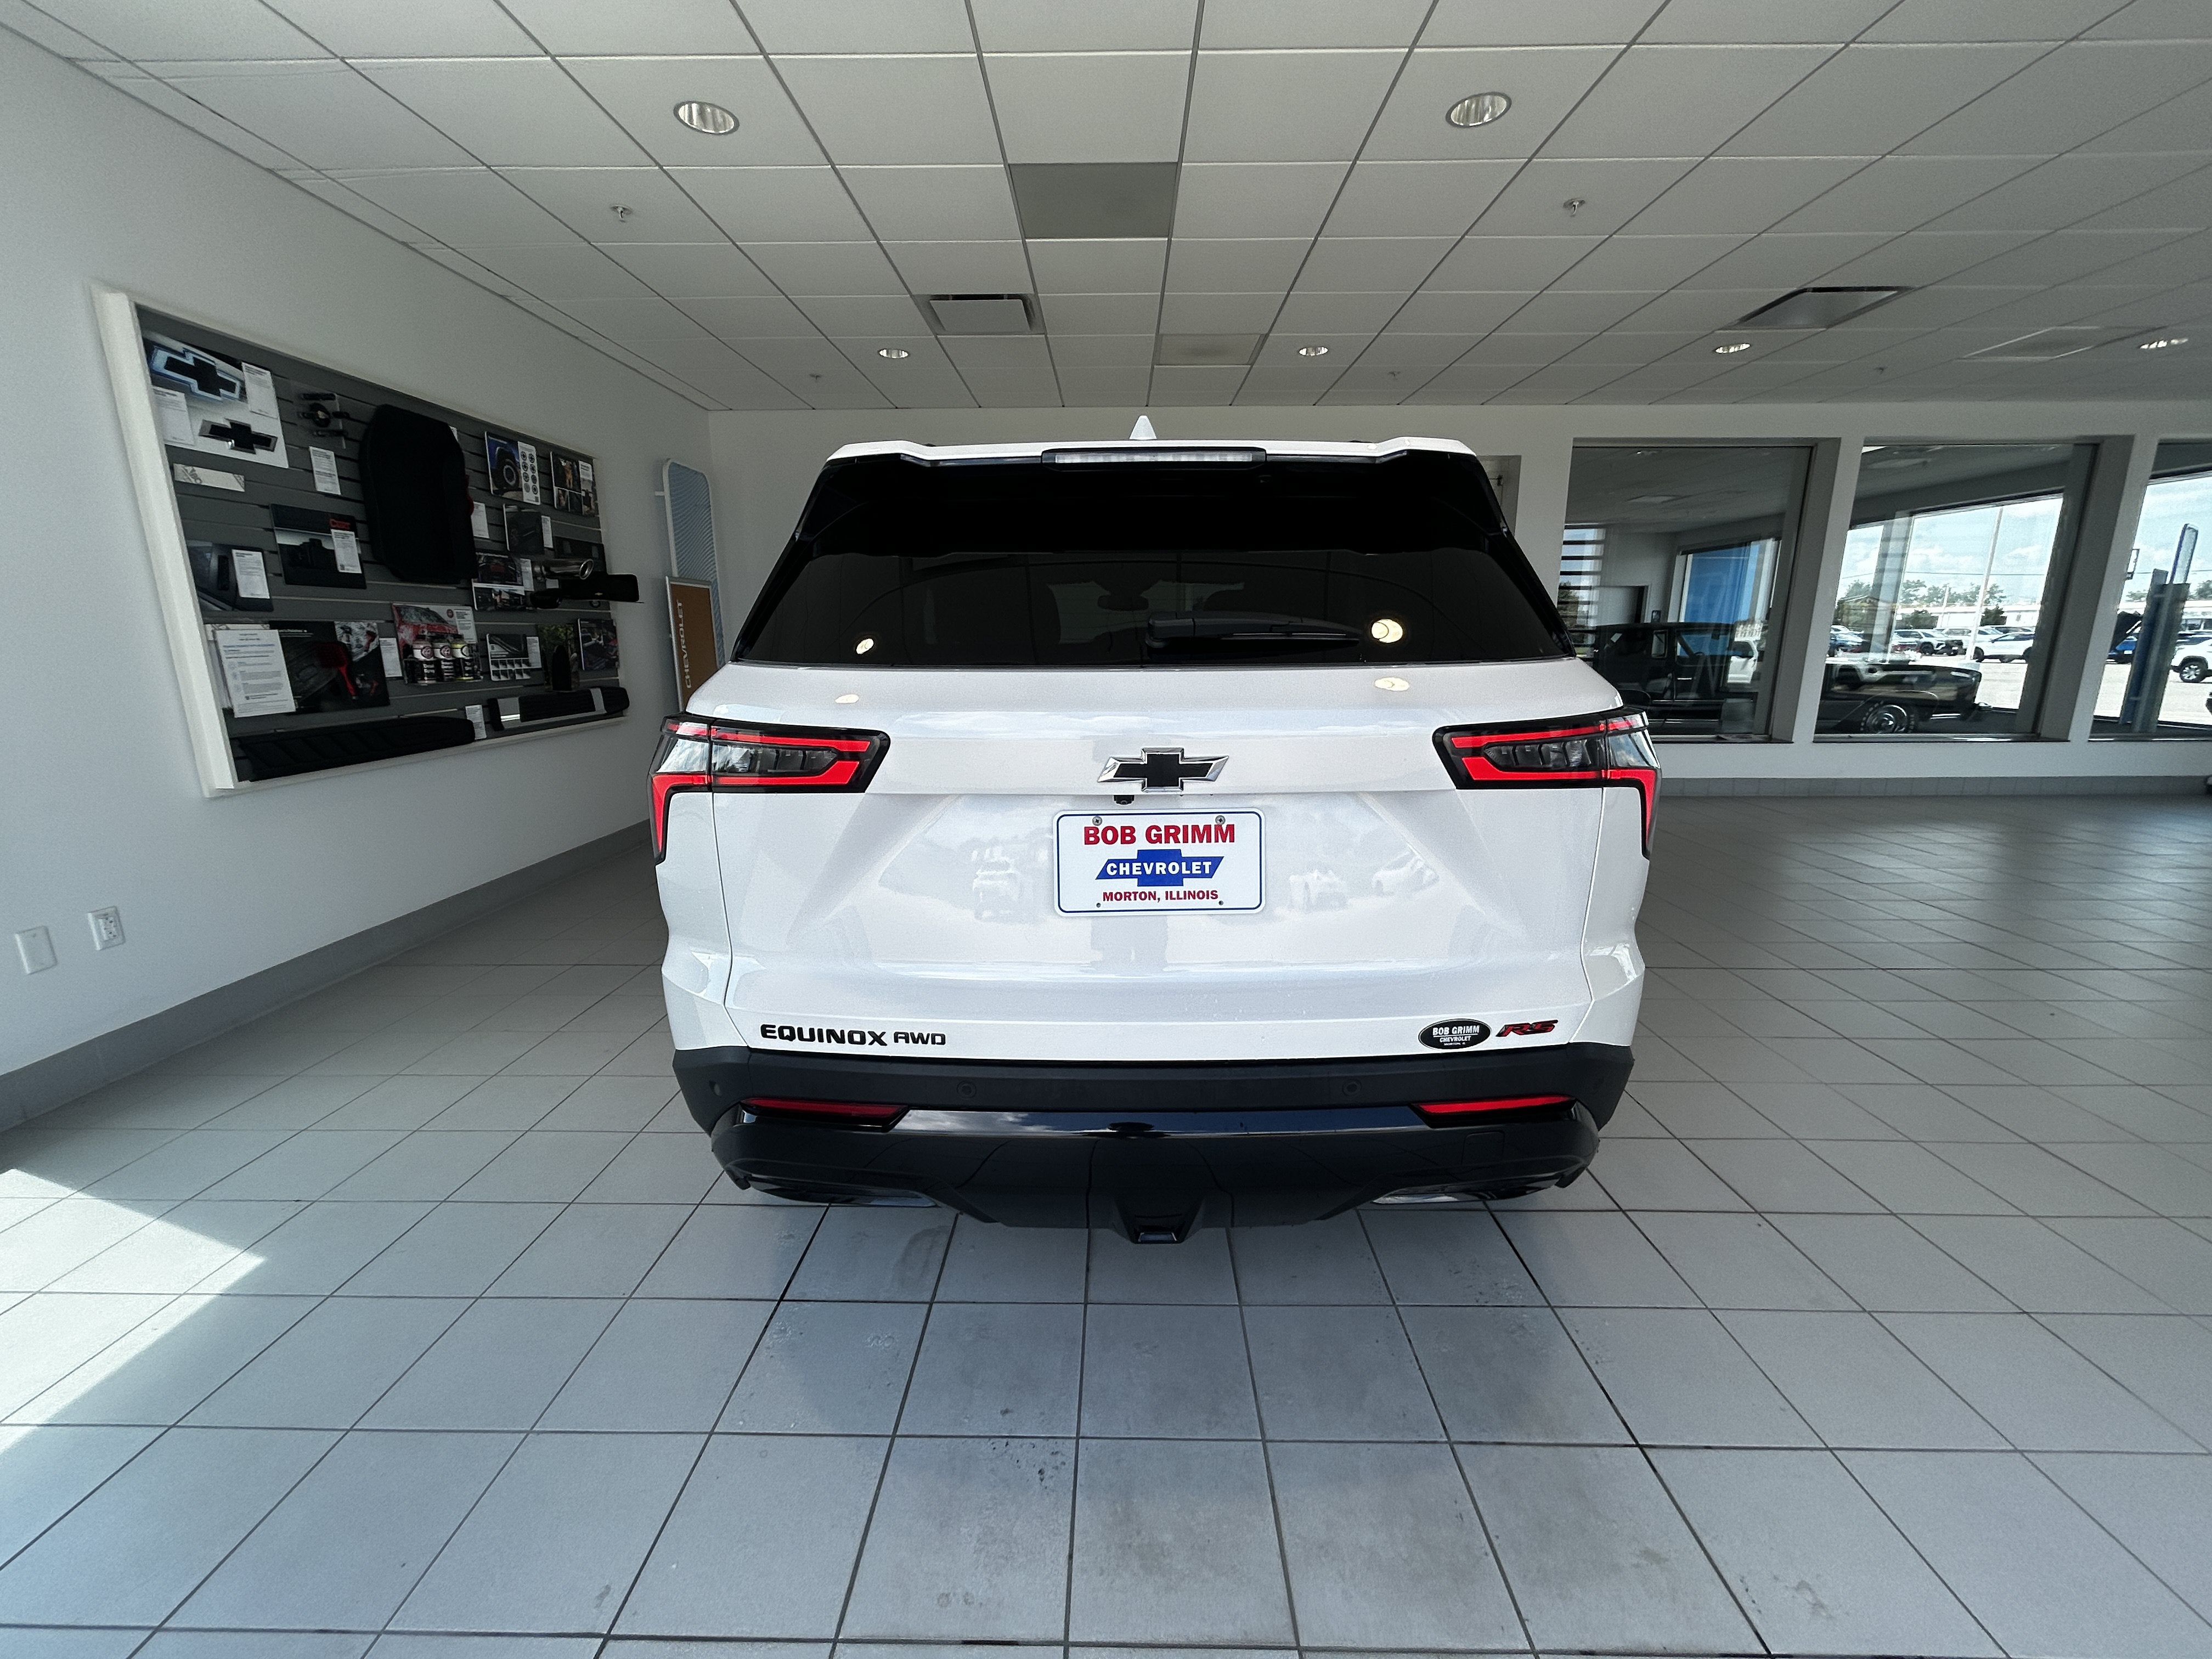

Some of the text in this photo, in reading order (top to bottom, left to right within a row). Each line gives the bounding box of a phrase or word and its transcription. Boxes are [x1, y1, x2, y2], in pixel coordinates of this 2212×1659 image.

[676, 599, 692, 689] CHEVROLET
[1084, 824, 1235, 845] BOB GRIMM
[1106, 861, 1212, 876] CHEVROLET
[1103, 890, 1218, 902] MORTON, ILLINOIS
[760, 1024, 946, 1046] EQUINOX AWD
[1432, 1025, 1480, 1036] BOB GRIMM
[1496, 1019, 1559, 1037] RS
